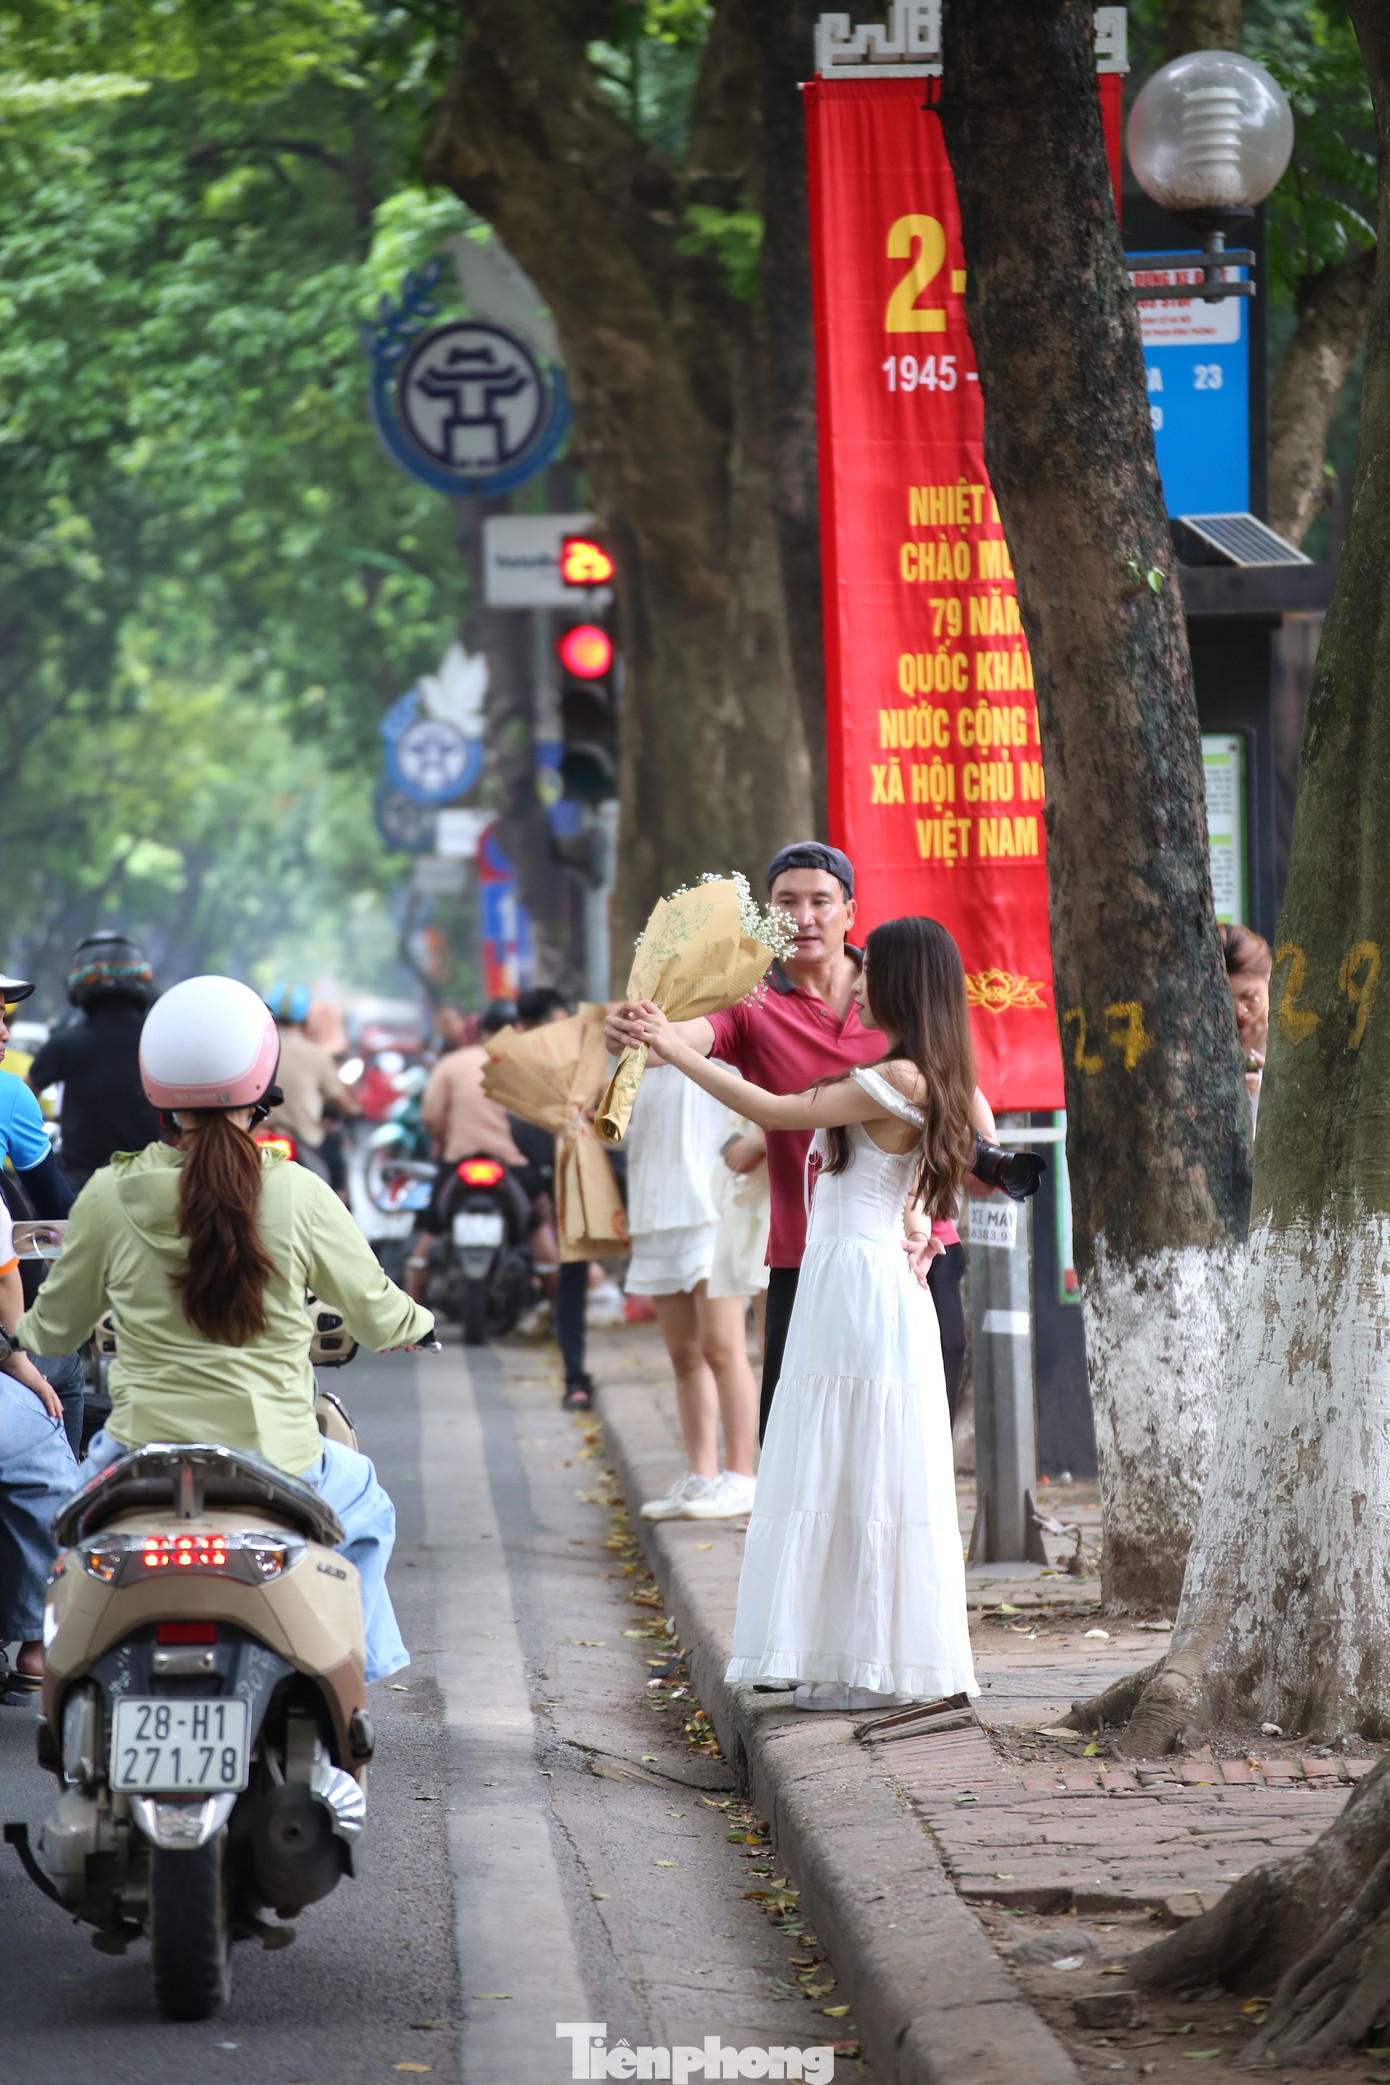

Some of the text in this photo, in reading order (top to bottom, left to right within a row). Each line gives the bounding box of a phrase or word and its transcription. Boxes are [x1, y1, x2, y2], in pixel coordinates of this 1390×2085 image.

[882, 354, 957, 392] 1945
[1193, 363, 1224, 390] 23
[909, 476, 986, 534] NHIỆT
[901, 532, 971, 583] CHÀO
[929, 597, 963, 637] 79
[899, 638, 969, 697] QUỐC
[879, 700, 950, 749] NƯỚC
[957, 698, 1028, 756] CỘNG
[871, 756, 906, 804] XÃ
[911, 755, 956, 812] HỘI
[962, 748, 1014, 803] CHỦ
[916, 810, 1039, 867] VIỆT NAM
[1275, 940, 1381, 1050] 29
[1063, 1000, 1153, 1075] 27
[122, 1746, 237, 1784] 271.78
